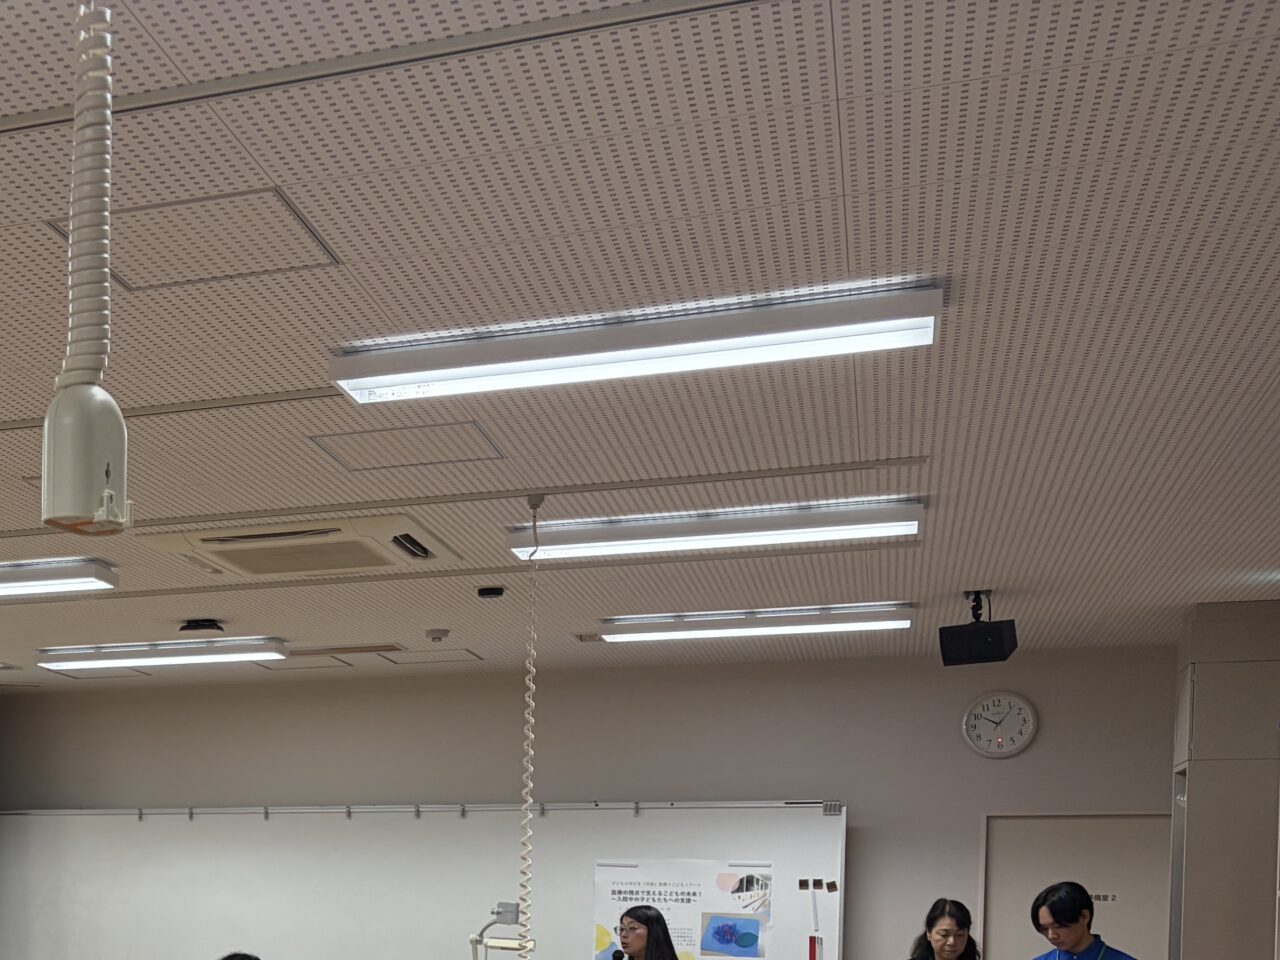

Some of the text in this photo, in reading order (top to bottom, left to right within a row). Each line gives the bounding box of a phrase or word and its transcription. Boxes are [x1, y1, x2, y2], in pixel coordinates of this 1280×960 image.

[992, 698, 1001, 707] 12
[982, 703, 989, 712] 11
[974, 712, 982, 720] 10
[971, 723, 976, 731] 9
[976, 733, 982, 741] 8
[1111, 894, 1117, 902] 2
